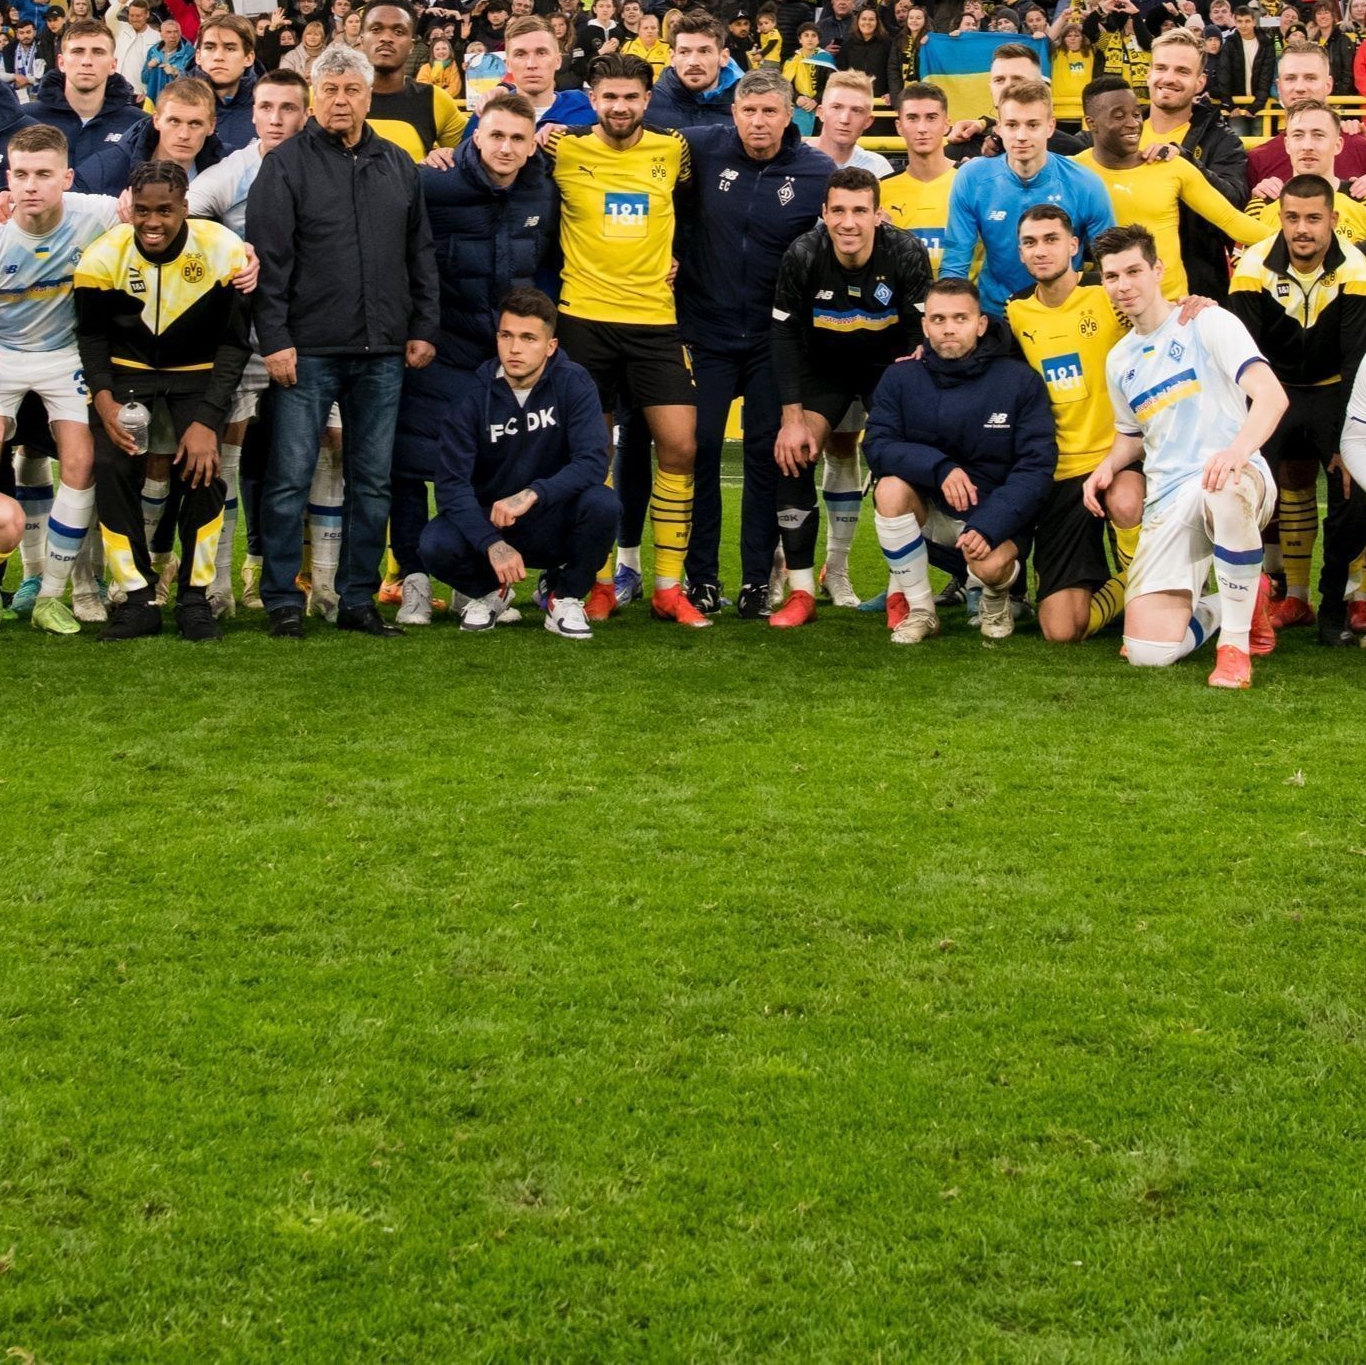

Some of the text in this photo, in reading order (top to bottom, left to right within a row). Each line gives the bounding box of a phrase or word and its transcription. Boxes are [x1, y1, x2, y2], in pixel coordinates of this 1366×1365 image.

[718, 179, 731, 192] EC
[609, 203, 645, 226] 1&1
[184, 263, 204, 277] BVB
[1080, 318, 1098, 334] BVB
[1047, 365, 1082, 391] 1&1
[490, 406, 556, 443] FC DK
